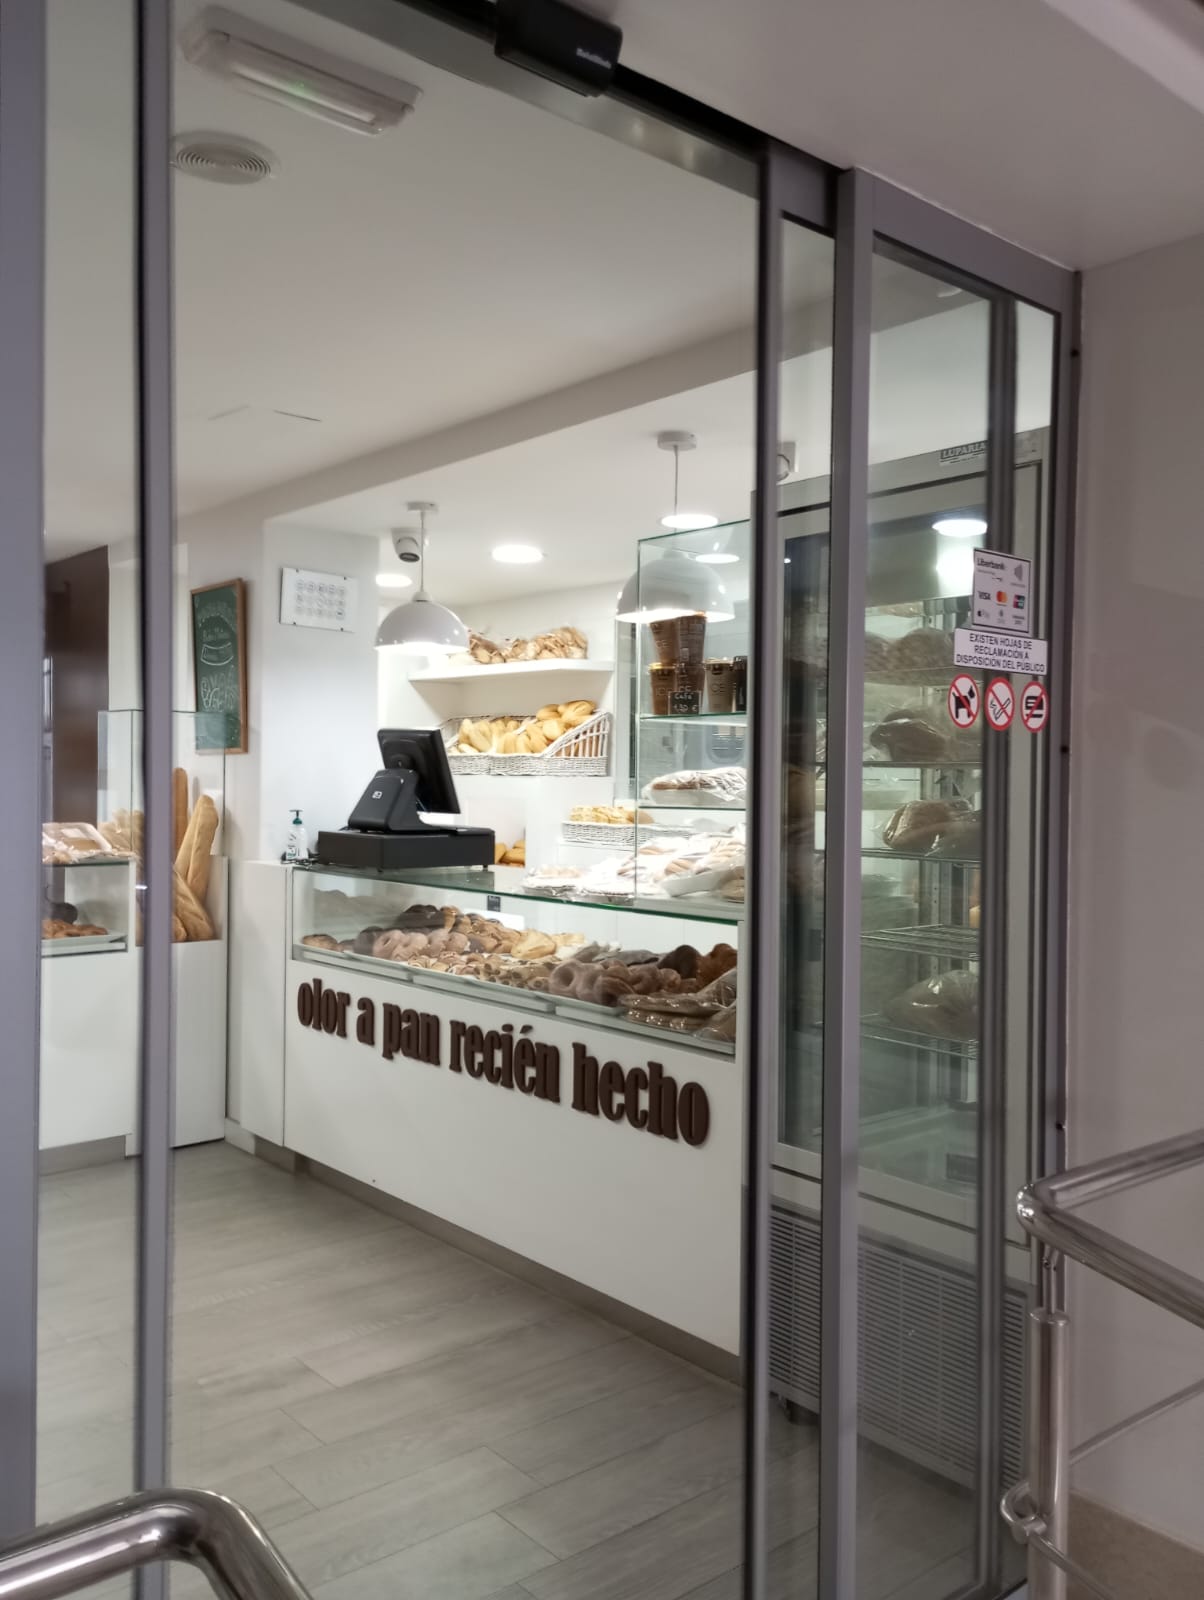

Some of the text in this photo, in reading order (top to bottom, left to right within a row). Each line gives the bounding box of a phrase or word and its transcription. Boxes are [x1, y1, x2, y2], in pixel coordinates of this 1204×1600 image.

[978, 590, 992, 602] VISA
[969, 633, 1032, 651] EXISTEN HOJAS DE
[1024, 651, 1030, 659] A
[1002, 660, 1015, 670] DEL
[297, 978, 710, 1147] olor a pan recién hecho
